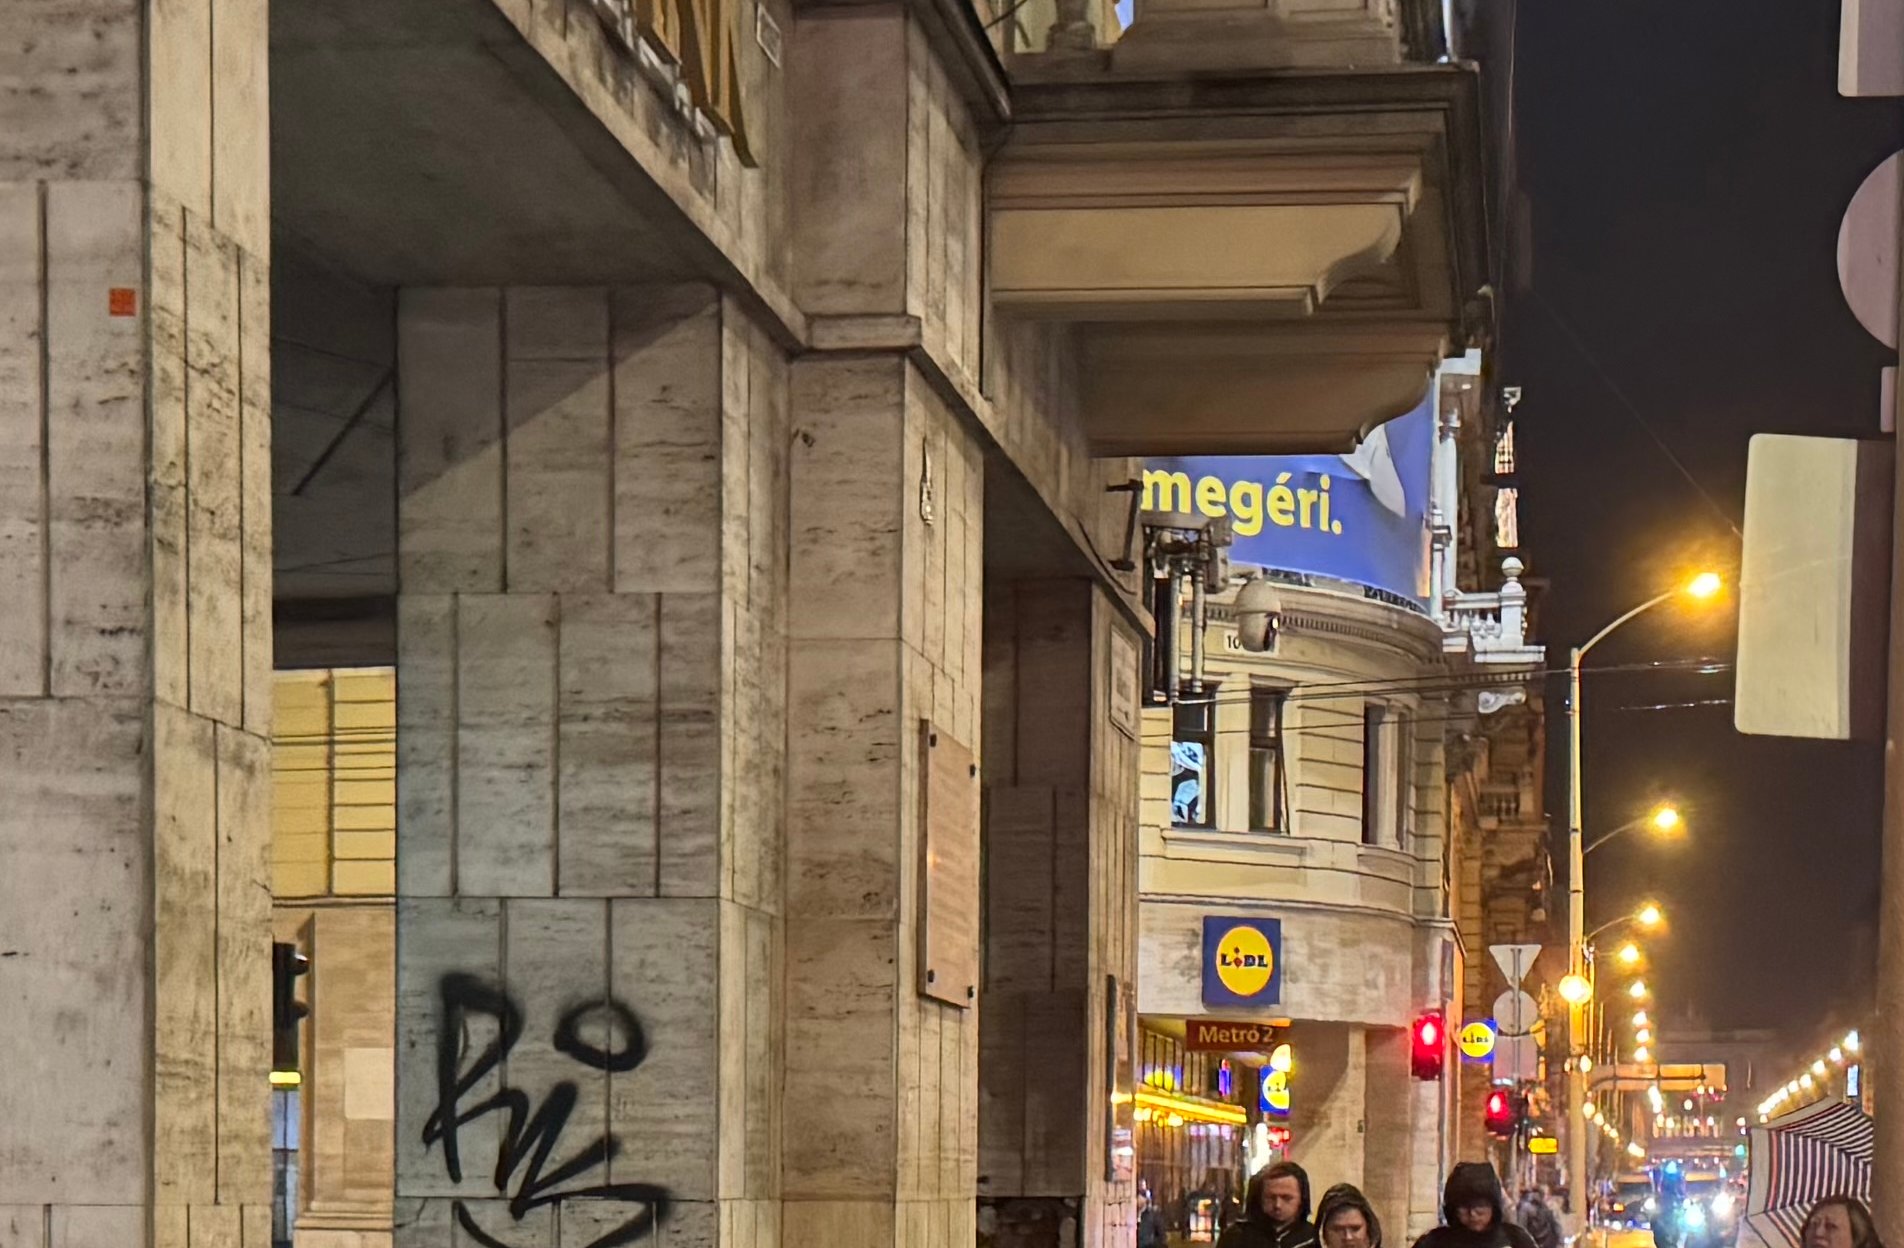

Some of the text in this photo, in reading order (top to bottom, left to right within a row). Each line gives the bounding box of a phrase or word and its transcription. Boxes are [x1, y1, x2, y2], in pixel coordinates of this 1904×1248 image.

[1139, 468, 1343, 536] megéri.
[1199, 1025, 1274, 1043] Metró 2
